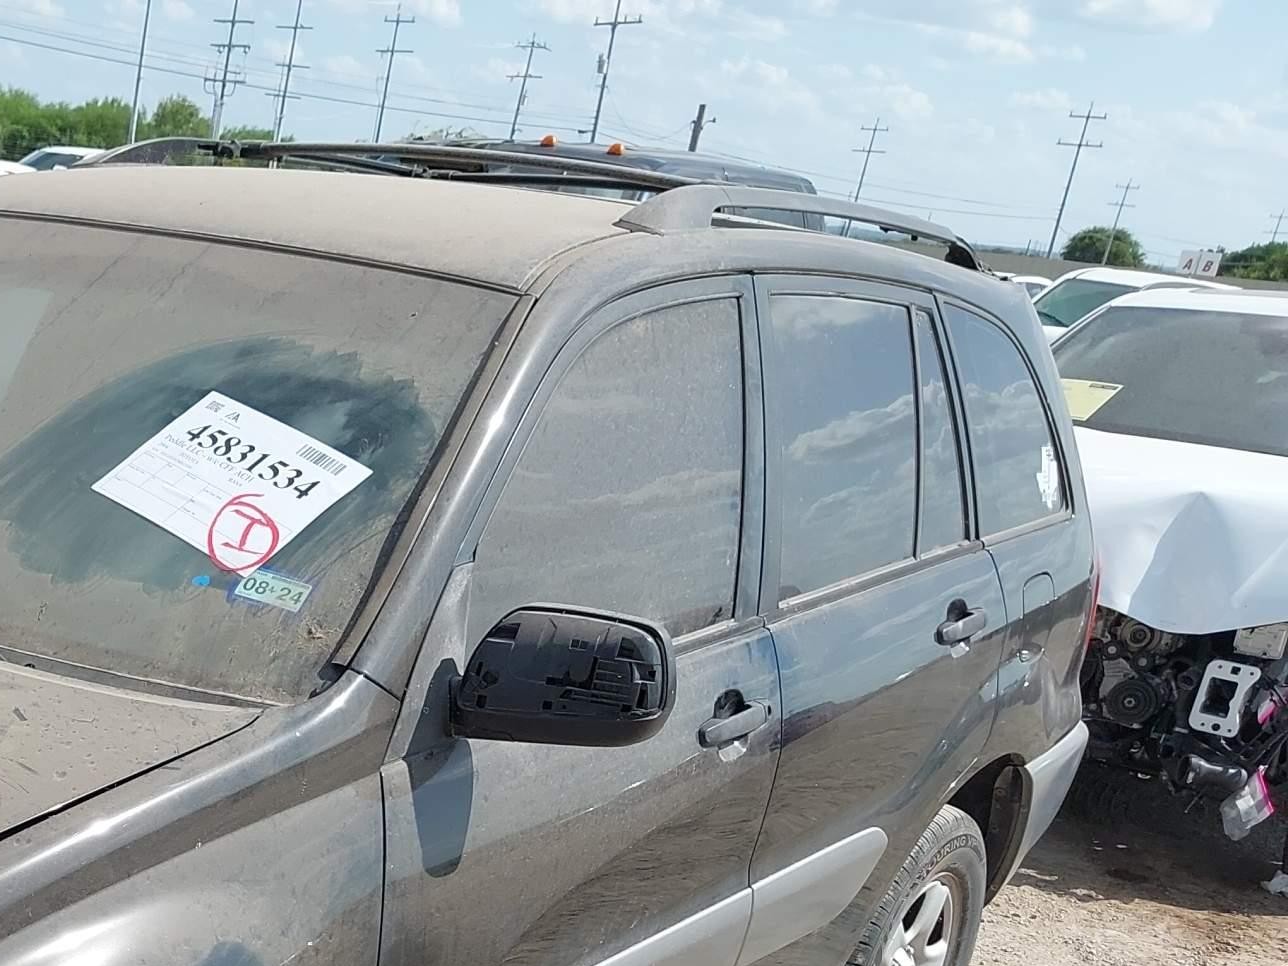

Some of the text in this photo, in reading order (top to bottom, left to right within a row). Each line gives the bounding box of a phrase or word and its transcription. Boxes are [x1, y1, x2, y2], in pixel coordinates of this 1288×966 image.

[1182, 258, 1193, 270] A
[1202, 260, 1214, 272] B
[186, 424, 321, 500] 45831534
